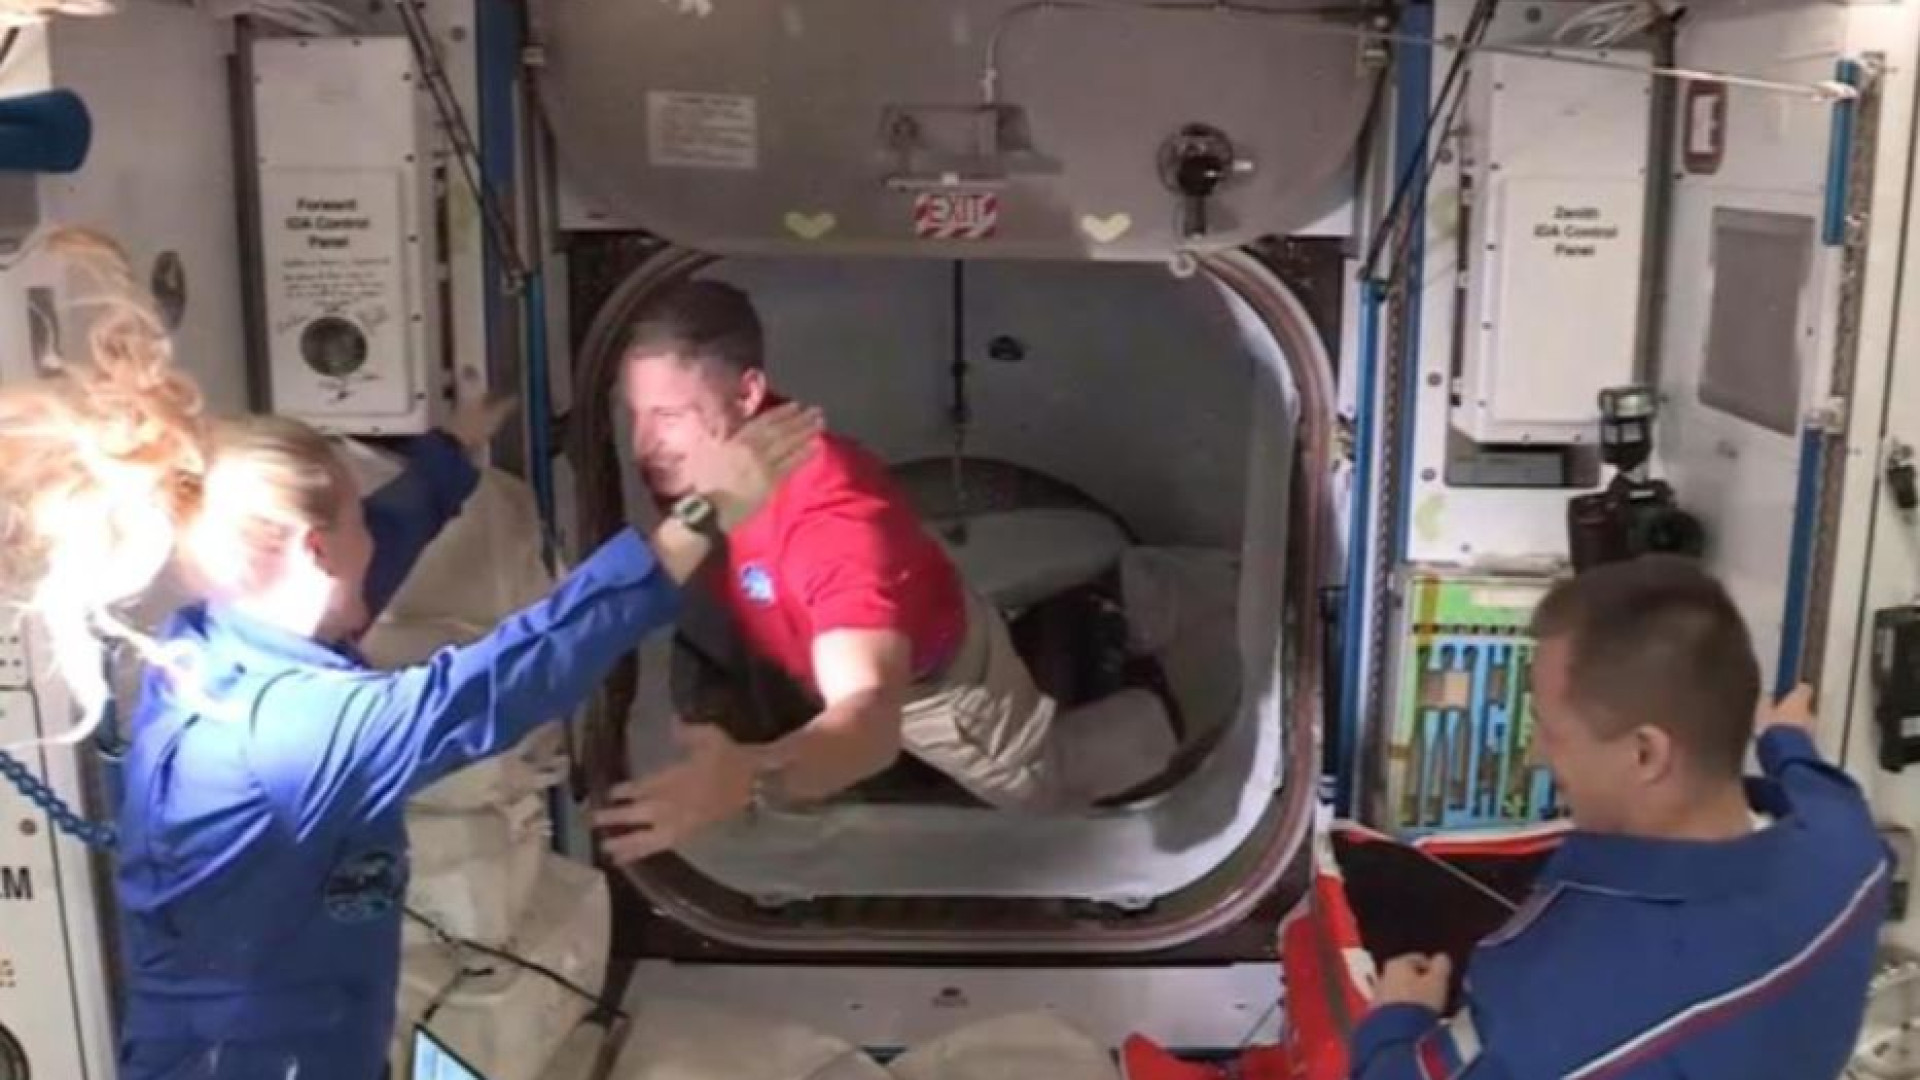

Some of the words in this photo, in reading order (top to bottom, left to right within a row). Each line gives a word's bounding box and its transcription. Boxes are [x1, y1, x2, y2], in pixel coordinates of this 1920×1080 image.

[296, 197, 357, 212] Forward
[1554, 205, 1600, 220] Zenith
[314, 216, 370, 230] Control
[1563, 223, 1618, 238] Control
[308, 234, 348, 248] Panel
[1554, 244, 1595, 257] Panel
